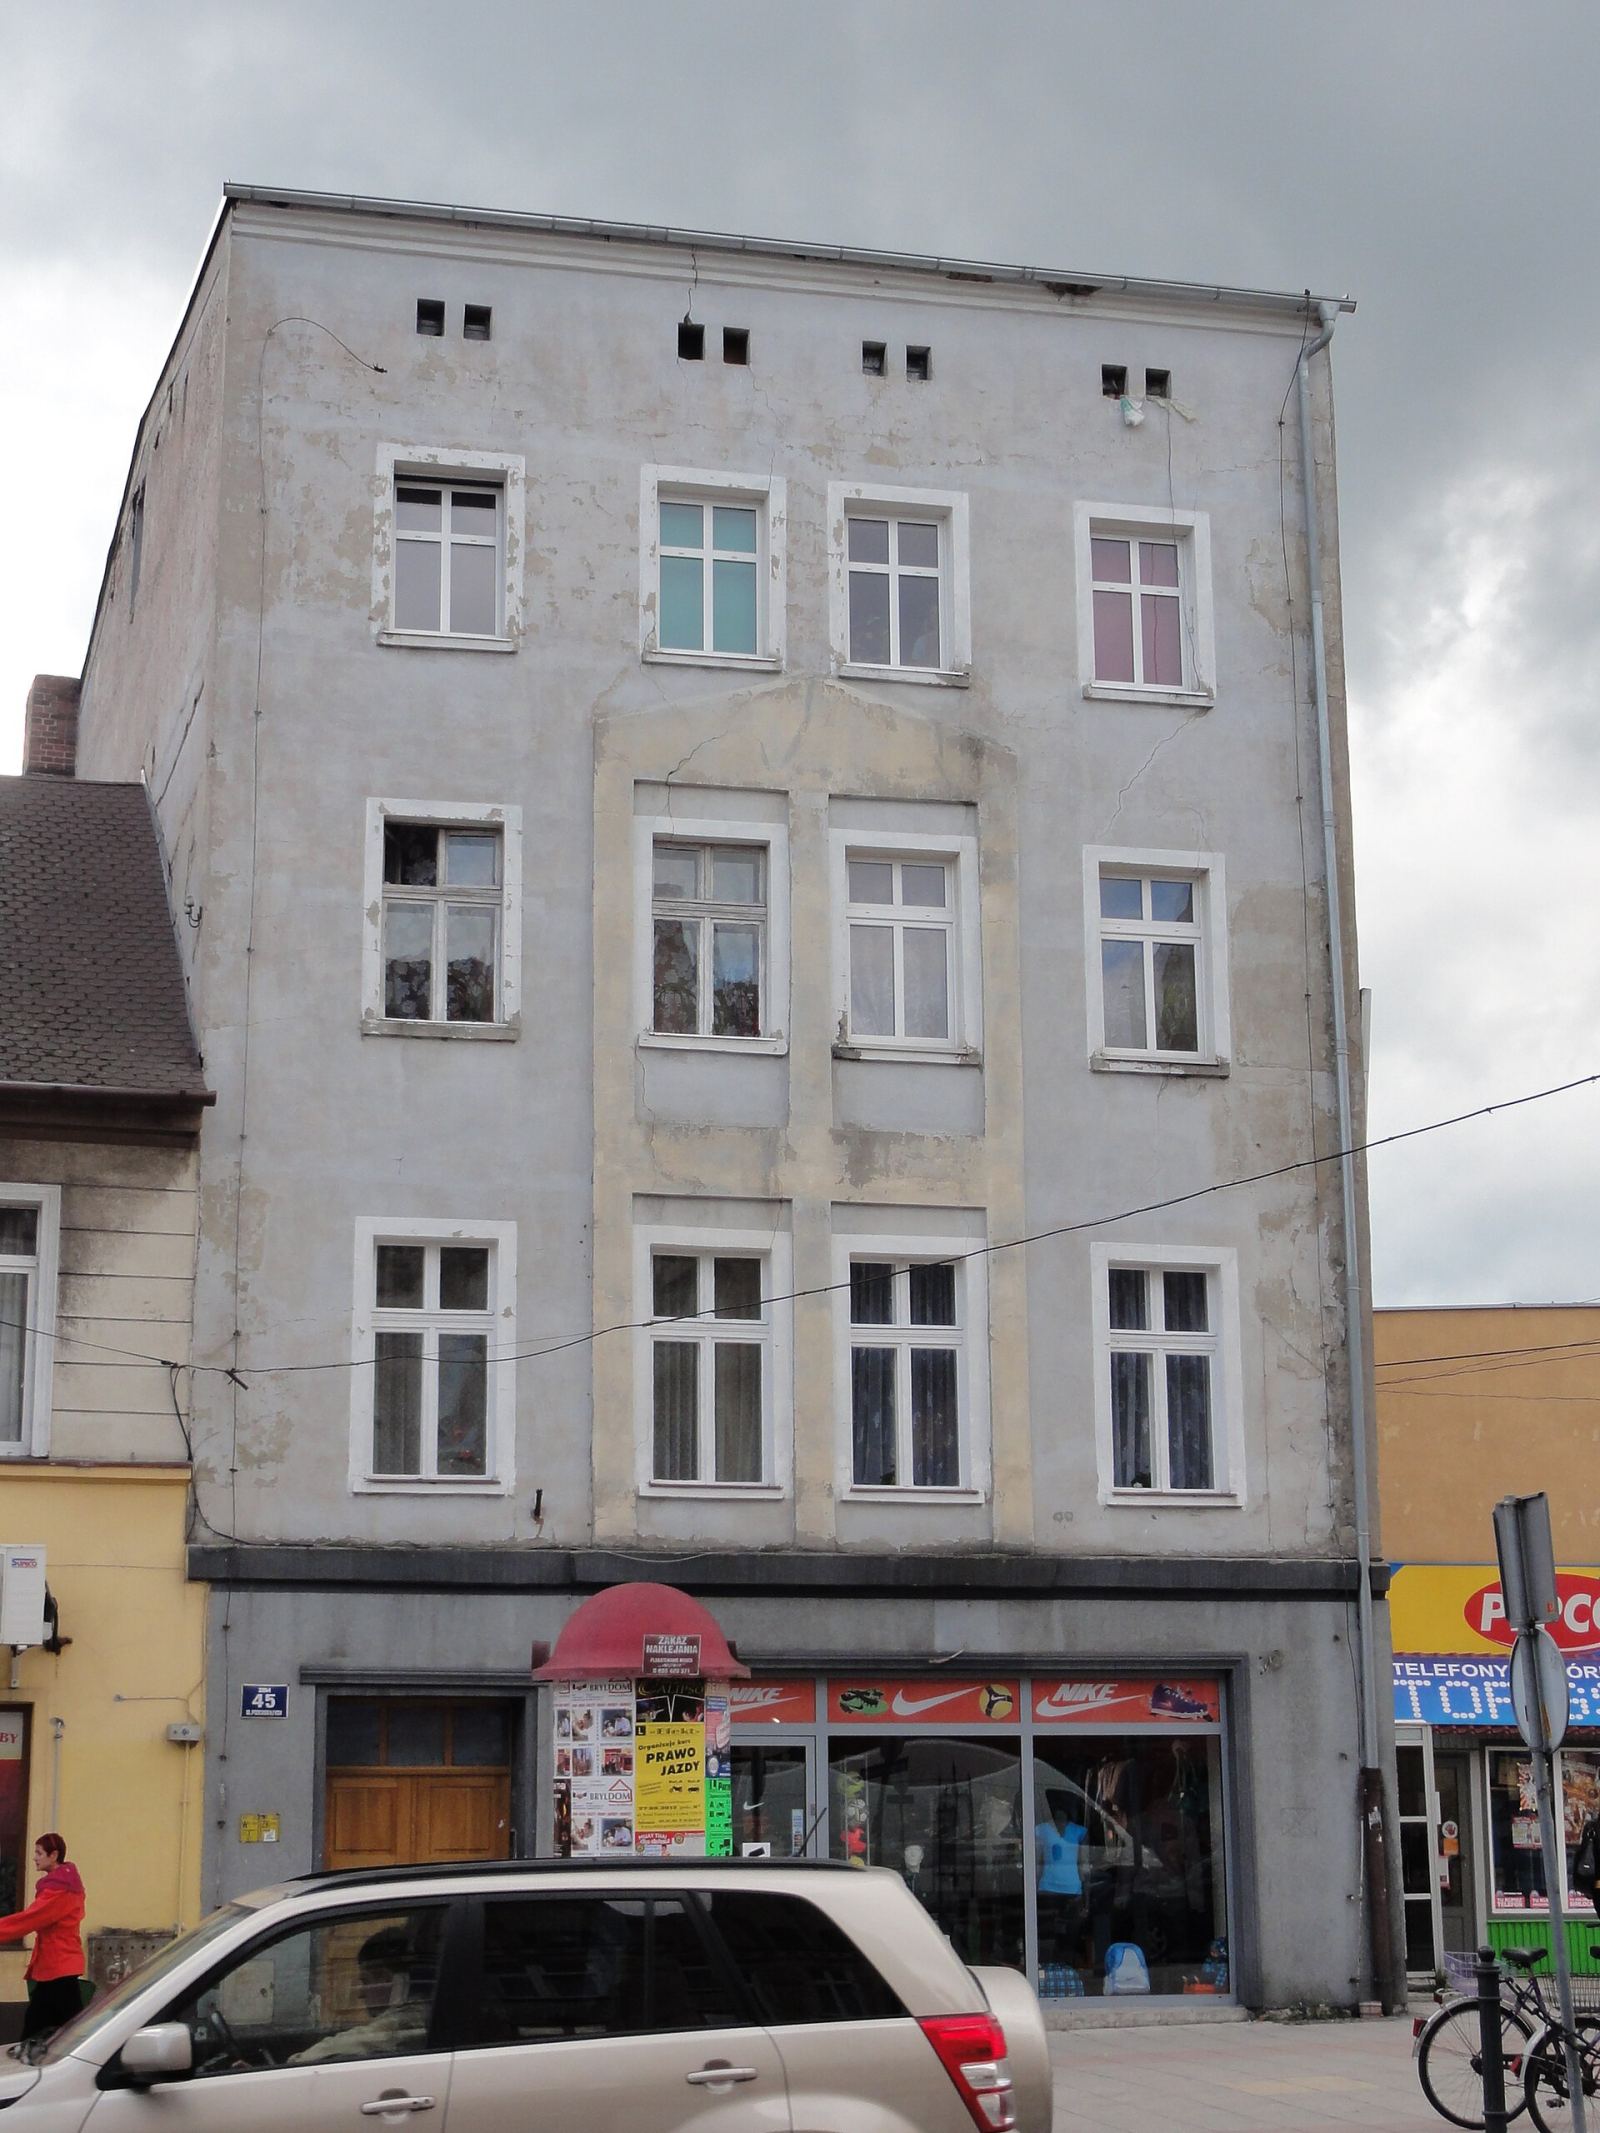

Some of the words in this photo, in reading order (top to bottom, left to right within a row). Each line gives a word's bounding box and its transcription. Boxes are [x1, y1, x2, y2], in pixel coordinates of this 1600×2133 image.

[658, 1636, 688, 1645] ZAKAZ
[646, 1645, 698, 1654] NAKLEJANIA
[1392, 1662, 1508, 1678] TELEFONY
[730, 1687, 784, 1702] NIKE
[1052, 1683, 1119, 1701] NIKE
[252, 1693, 276, 1709] 45
[645, 1747, 696, 1764] PRAWO
[660, 1761, 700, 1776] JAZDY
[589, 1792, 631, 1801] BRYLDOM
